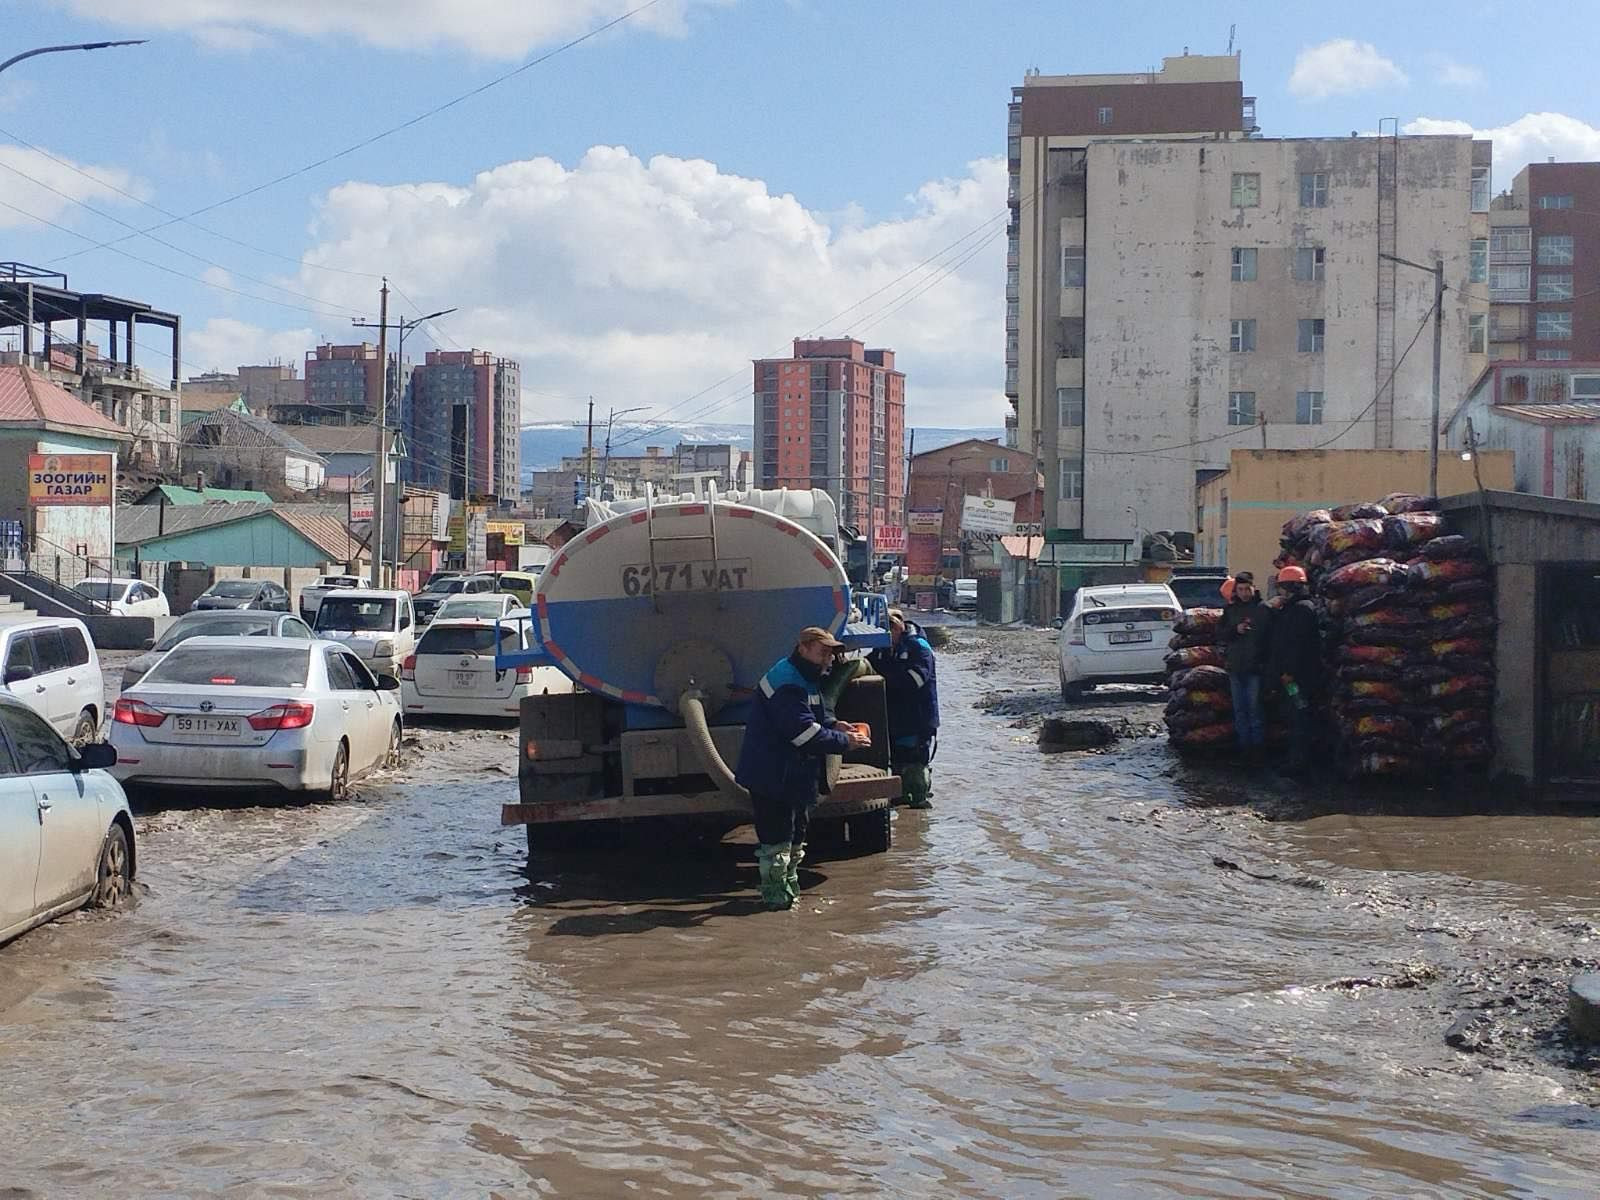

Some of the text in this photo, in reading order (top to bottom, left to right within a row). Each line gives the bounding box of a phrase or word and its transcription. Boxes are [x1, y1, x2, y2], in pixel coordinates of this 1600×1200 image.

[34, 472, 106, 484] ЗООГИЙН
[47, 485, 92, 495] ГАЗАР
[879, 527, 902, 538] АВТО
[623, 563, 692, 596] 6271
